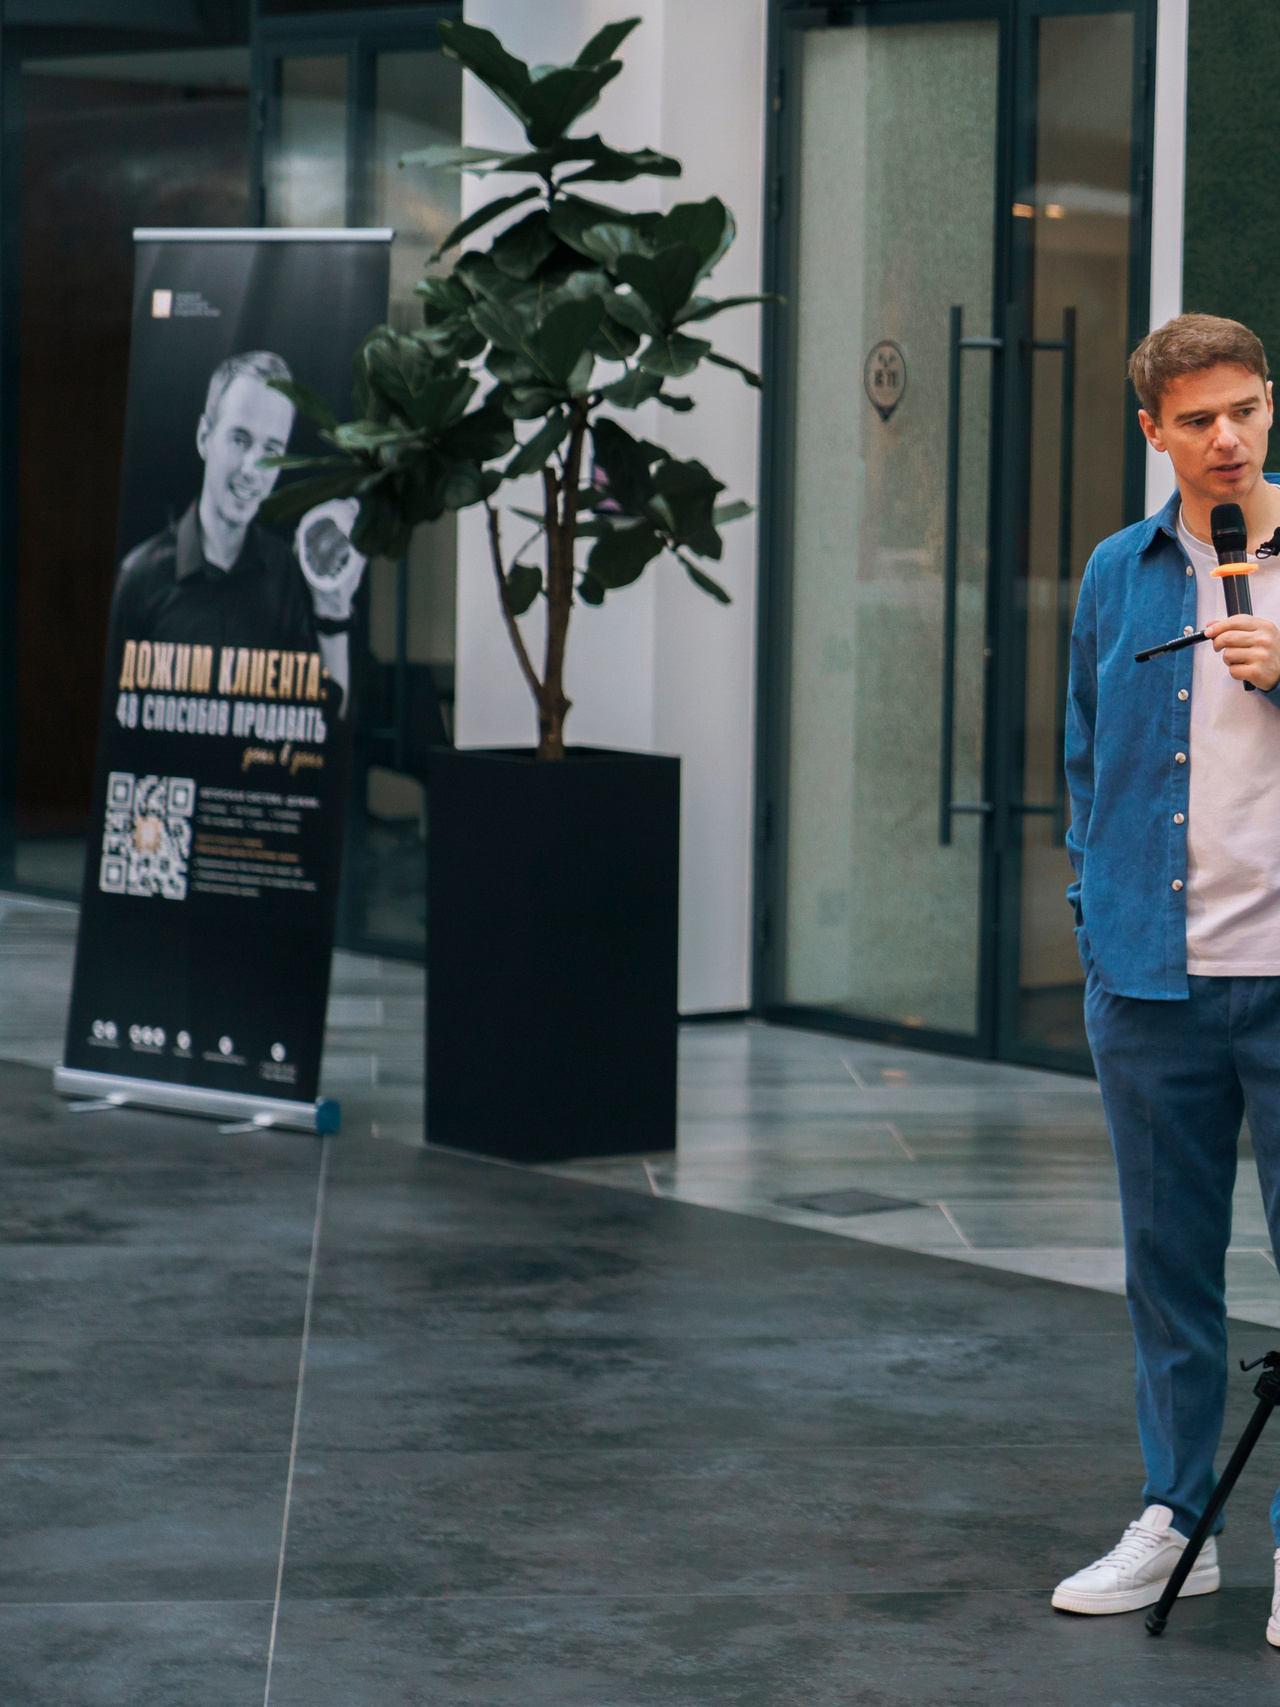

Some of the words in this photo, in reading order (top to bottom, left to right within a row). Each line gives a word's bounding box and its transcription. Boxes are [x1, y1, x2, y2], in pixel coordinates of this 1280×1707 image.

[119, 639, 213, 695] ДОЖИМ
[218, 646, 330, 701] КЛИЕНТА:
[142, 694, 229, 736] СПОСОБОВ
[232, 701, 327, 744] ПРОДАВАТЬ
